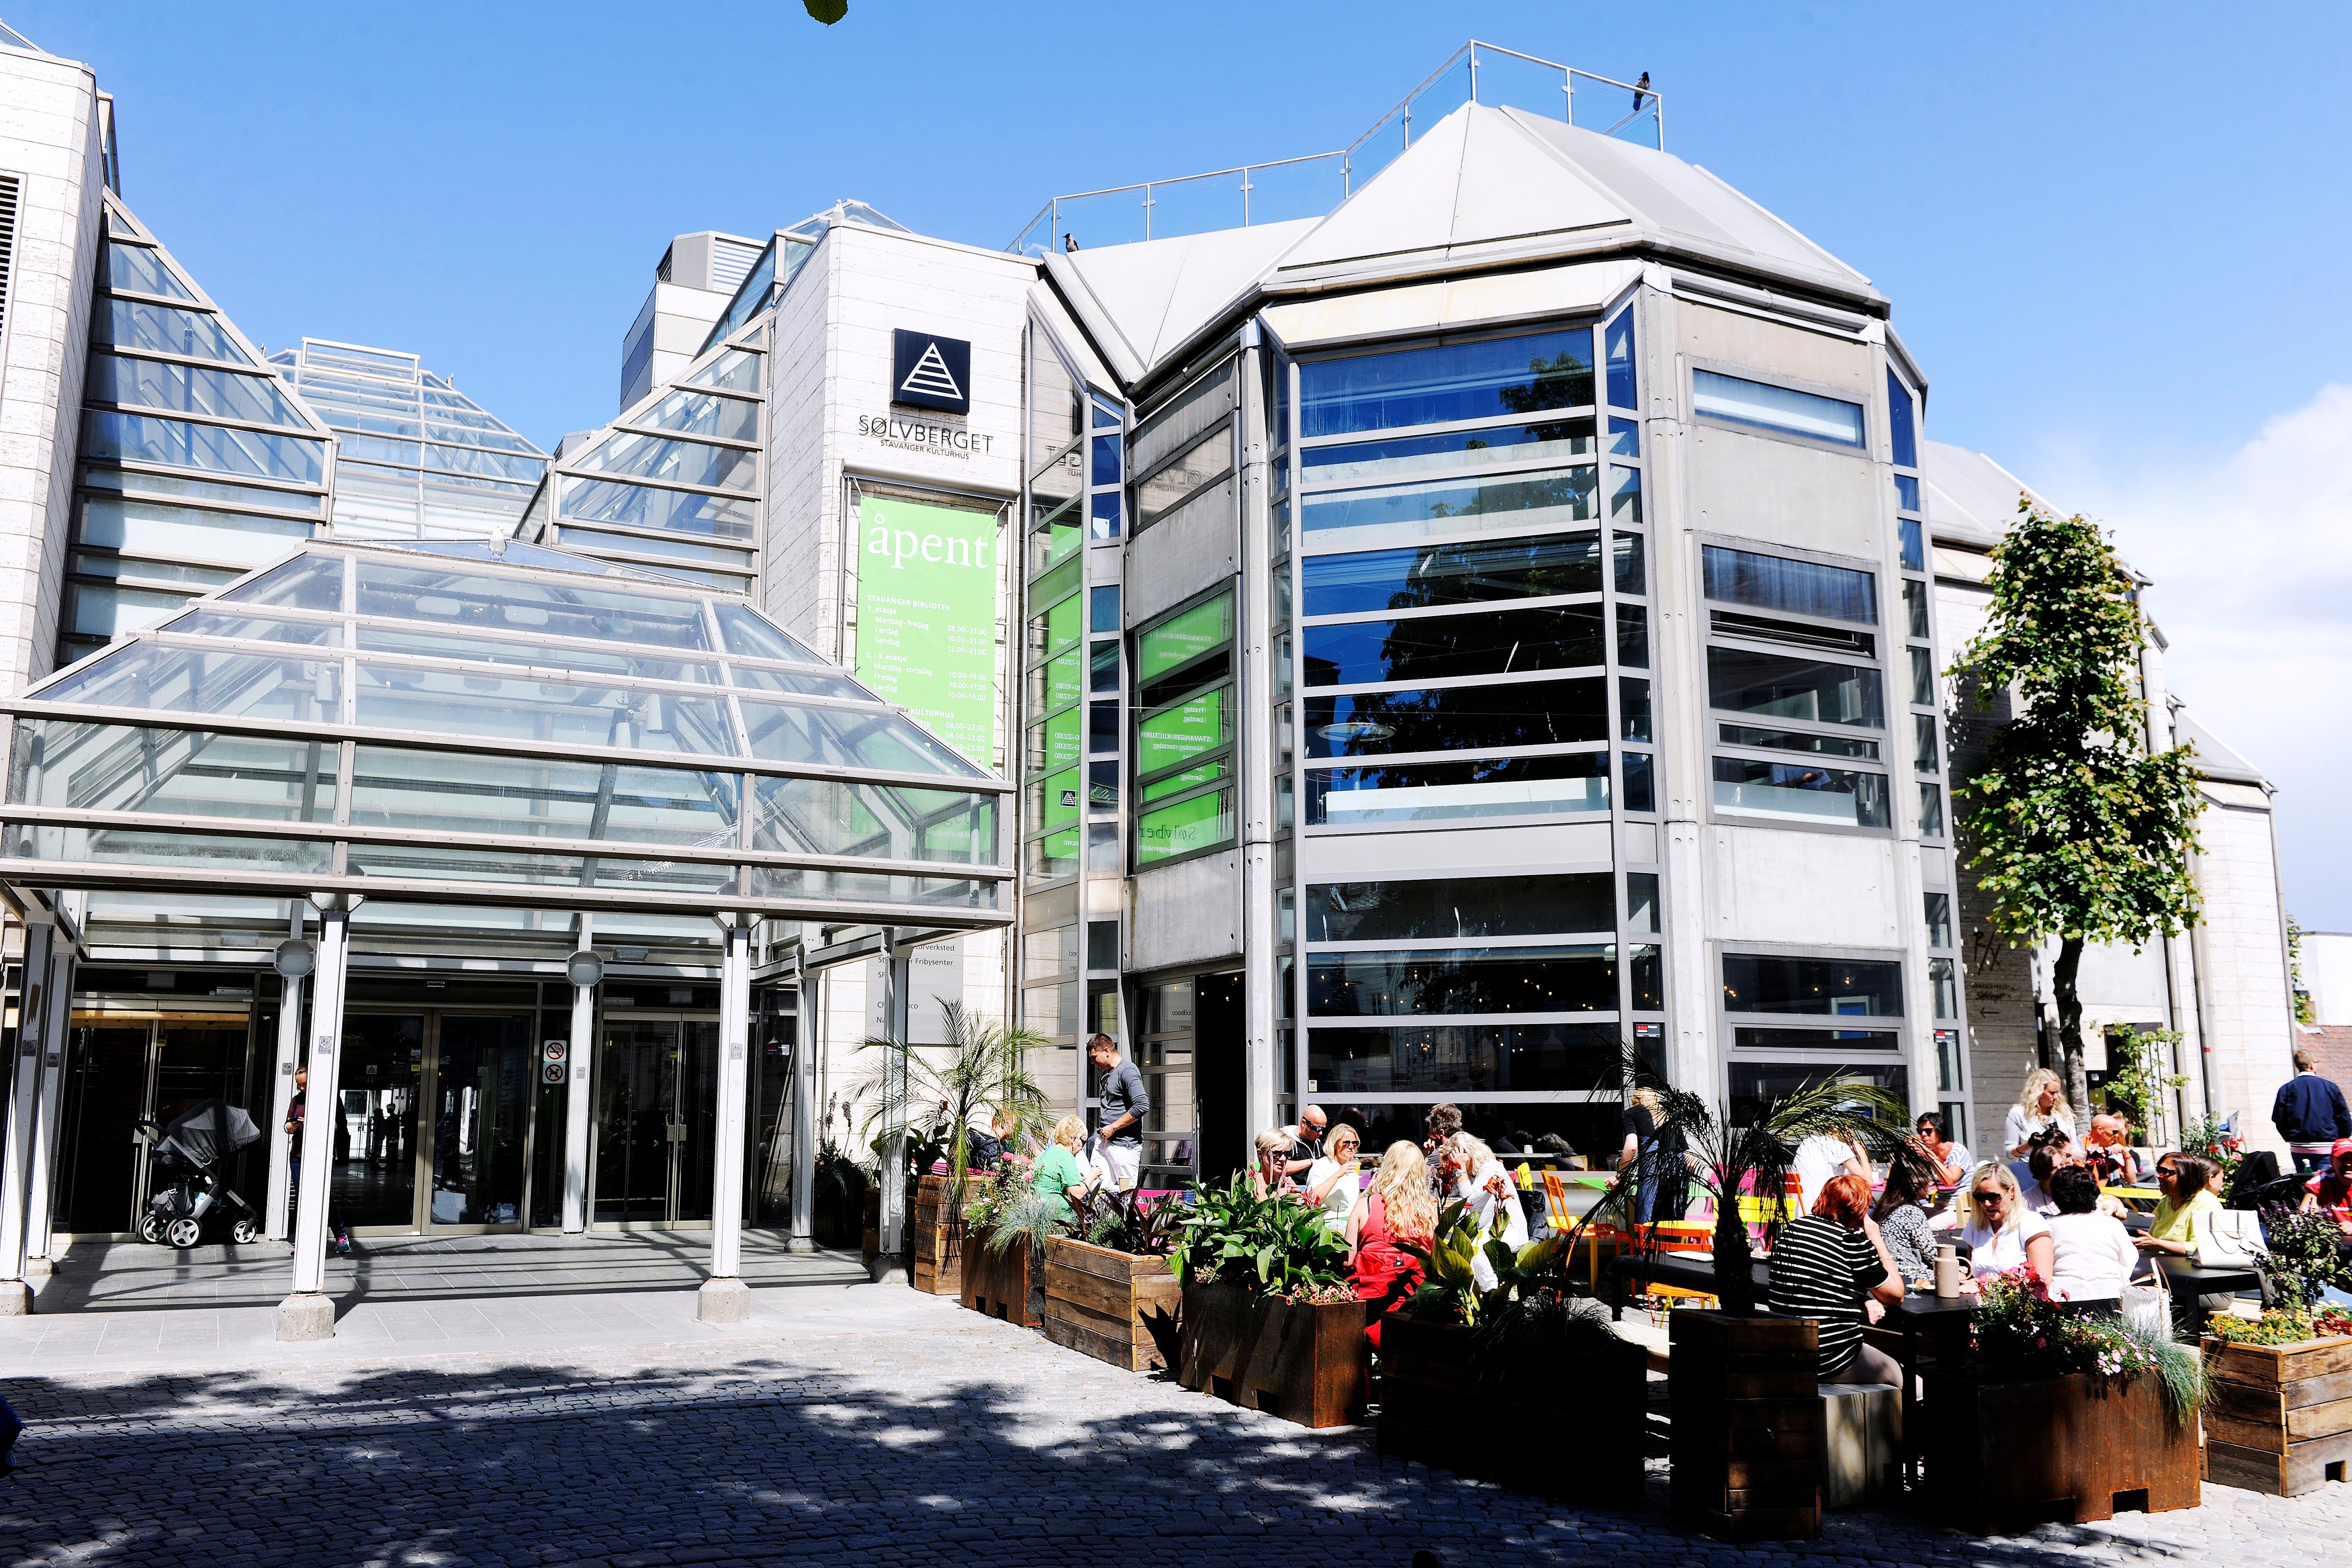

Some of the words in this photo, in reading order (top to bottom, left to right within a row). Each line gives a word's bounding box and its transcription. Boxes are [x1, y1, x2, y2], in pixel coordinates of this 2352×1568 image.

[859, 415, 994, 454] SØLVBERGET
[881, 440, 924, 453] STAVANGER
[927, 447, 969, 460] KULTURHUS
[868, 513, 989, 570] åpent
[867, 595, 911, 606] STAVANGER
[912, 600, 950, 611] BIBLIOTEK
[875, 607, 897, 616] etasje
[875, 626, 899, 637] Lørdag
[874, 637, 900, 647] Søndag
[885, 654, 907, 663] etasje
[873, 673, 897, 683] Fredag
[873, 684, 897, 693] Lørdag
[910, 708, 955, 718] KULTURHUS
[915, 958, 953, 966] Fribysenter
